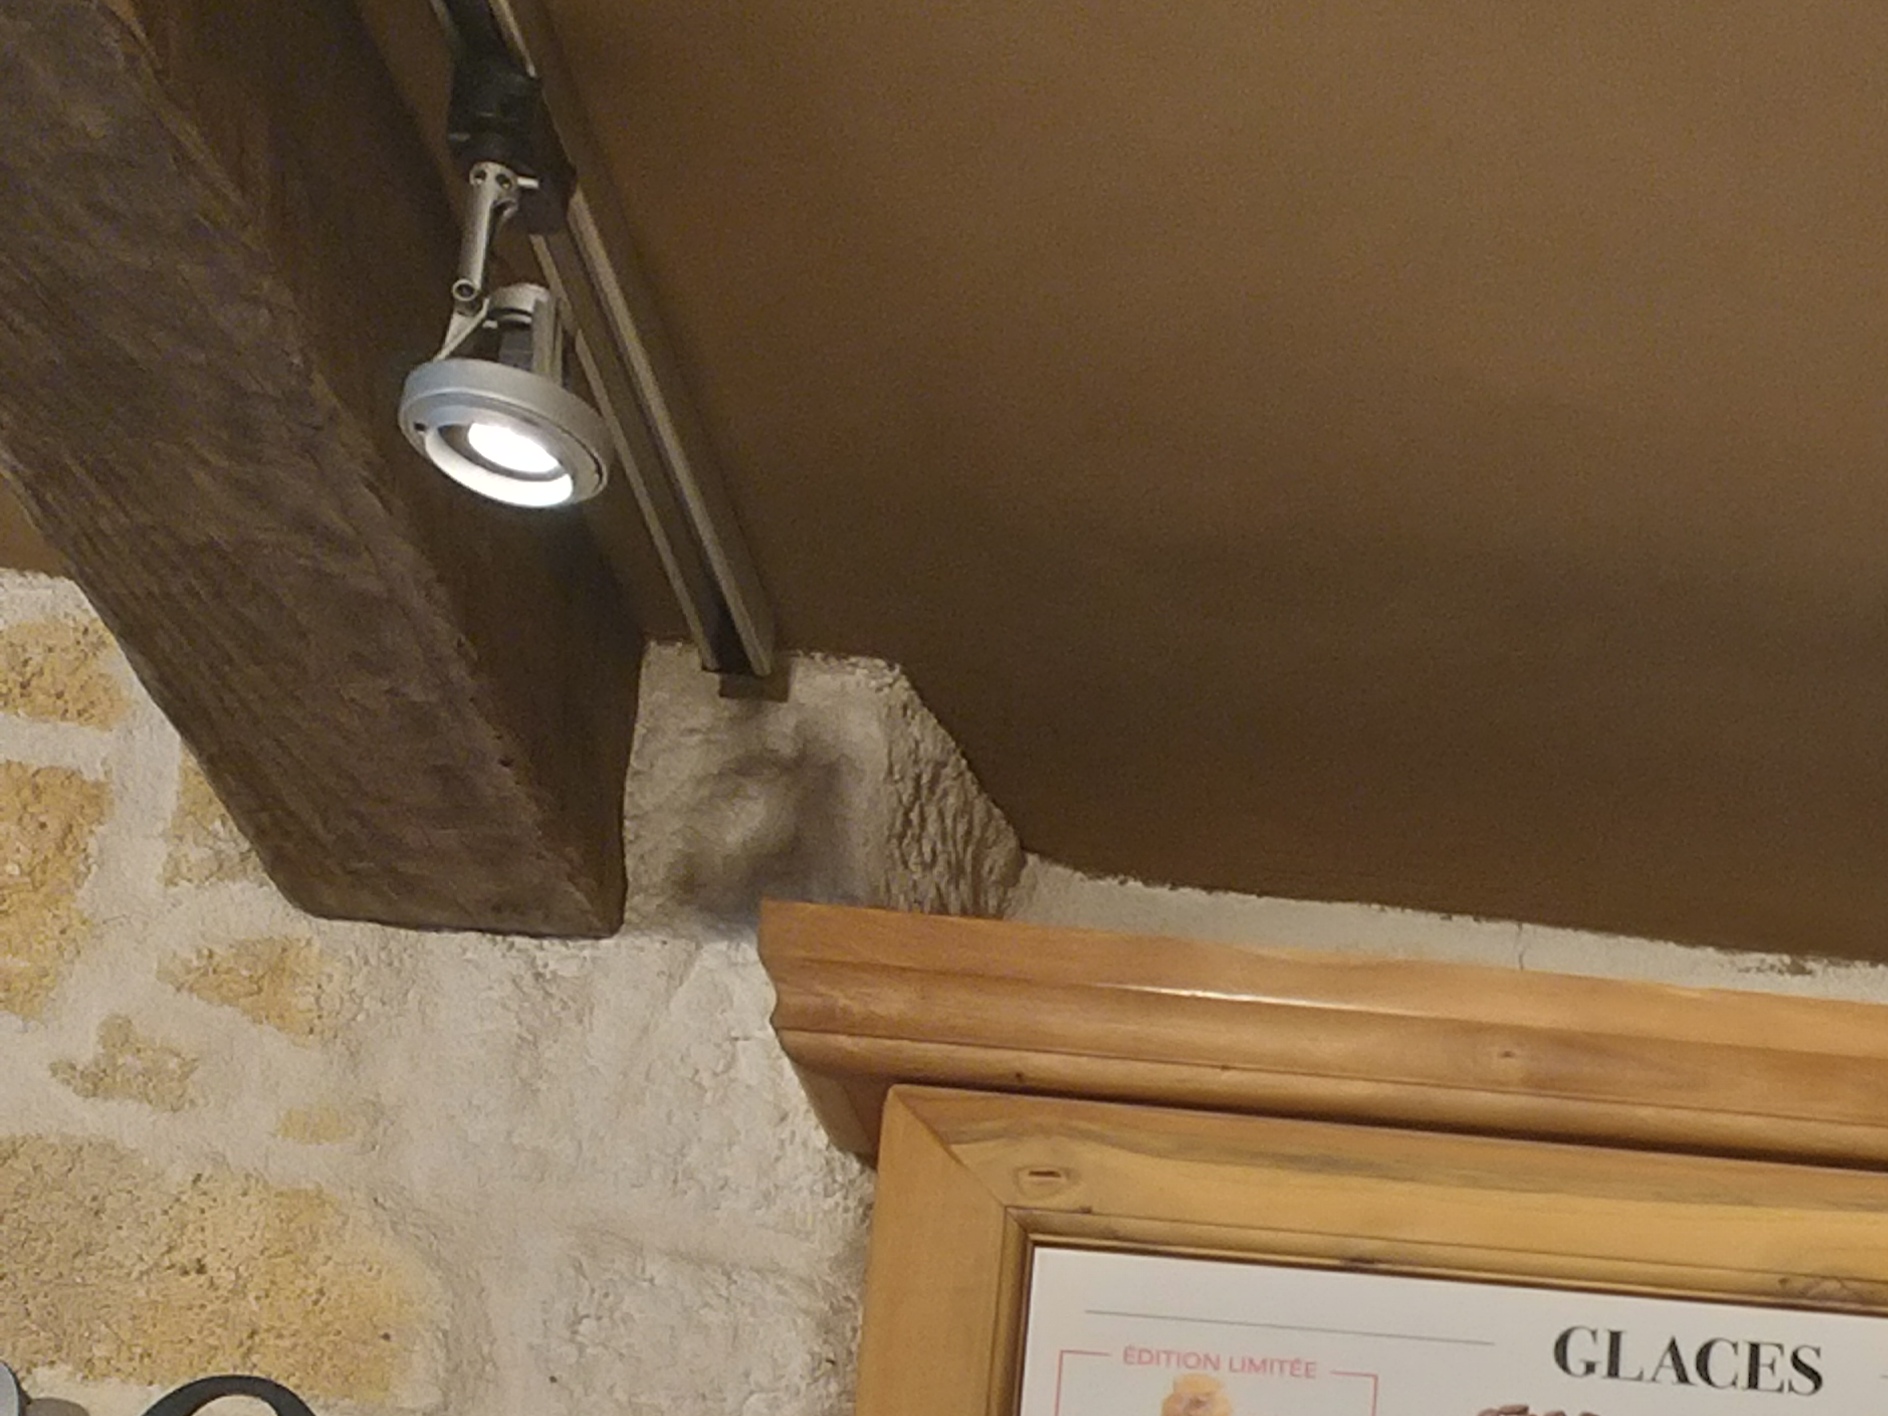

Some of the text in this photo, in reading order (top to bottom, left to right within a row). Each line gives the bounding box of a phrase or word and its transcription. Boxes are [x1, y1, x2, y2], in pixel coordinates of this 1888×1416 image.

[1123, 1345, 1318, 1379] ÉDITION LIMITÉE
[1553, 1324, 1824, 1396] GLACES
